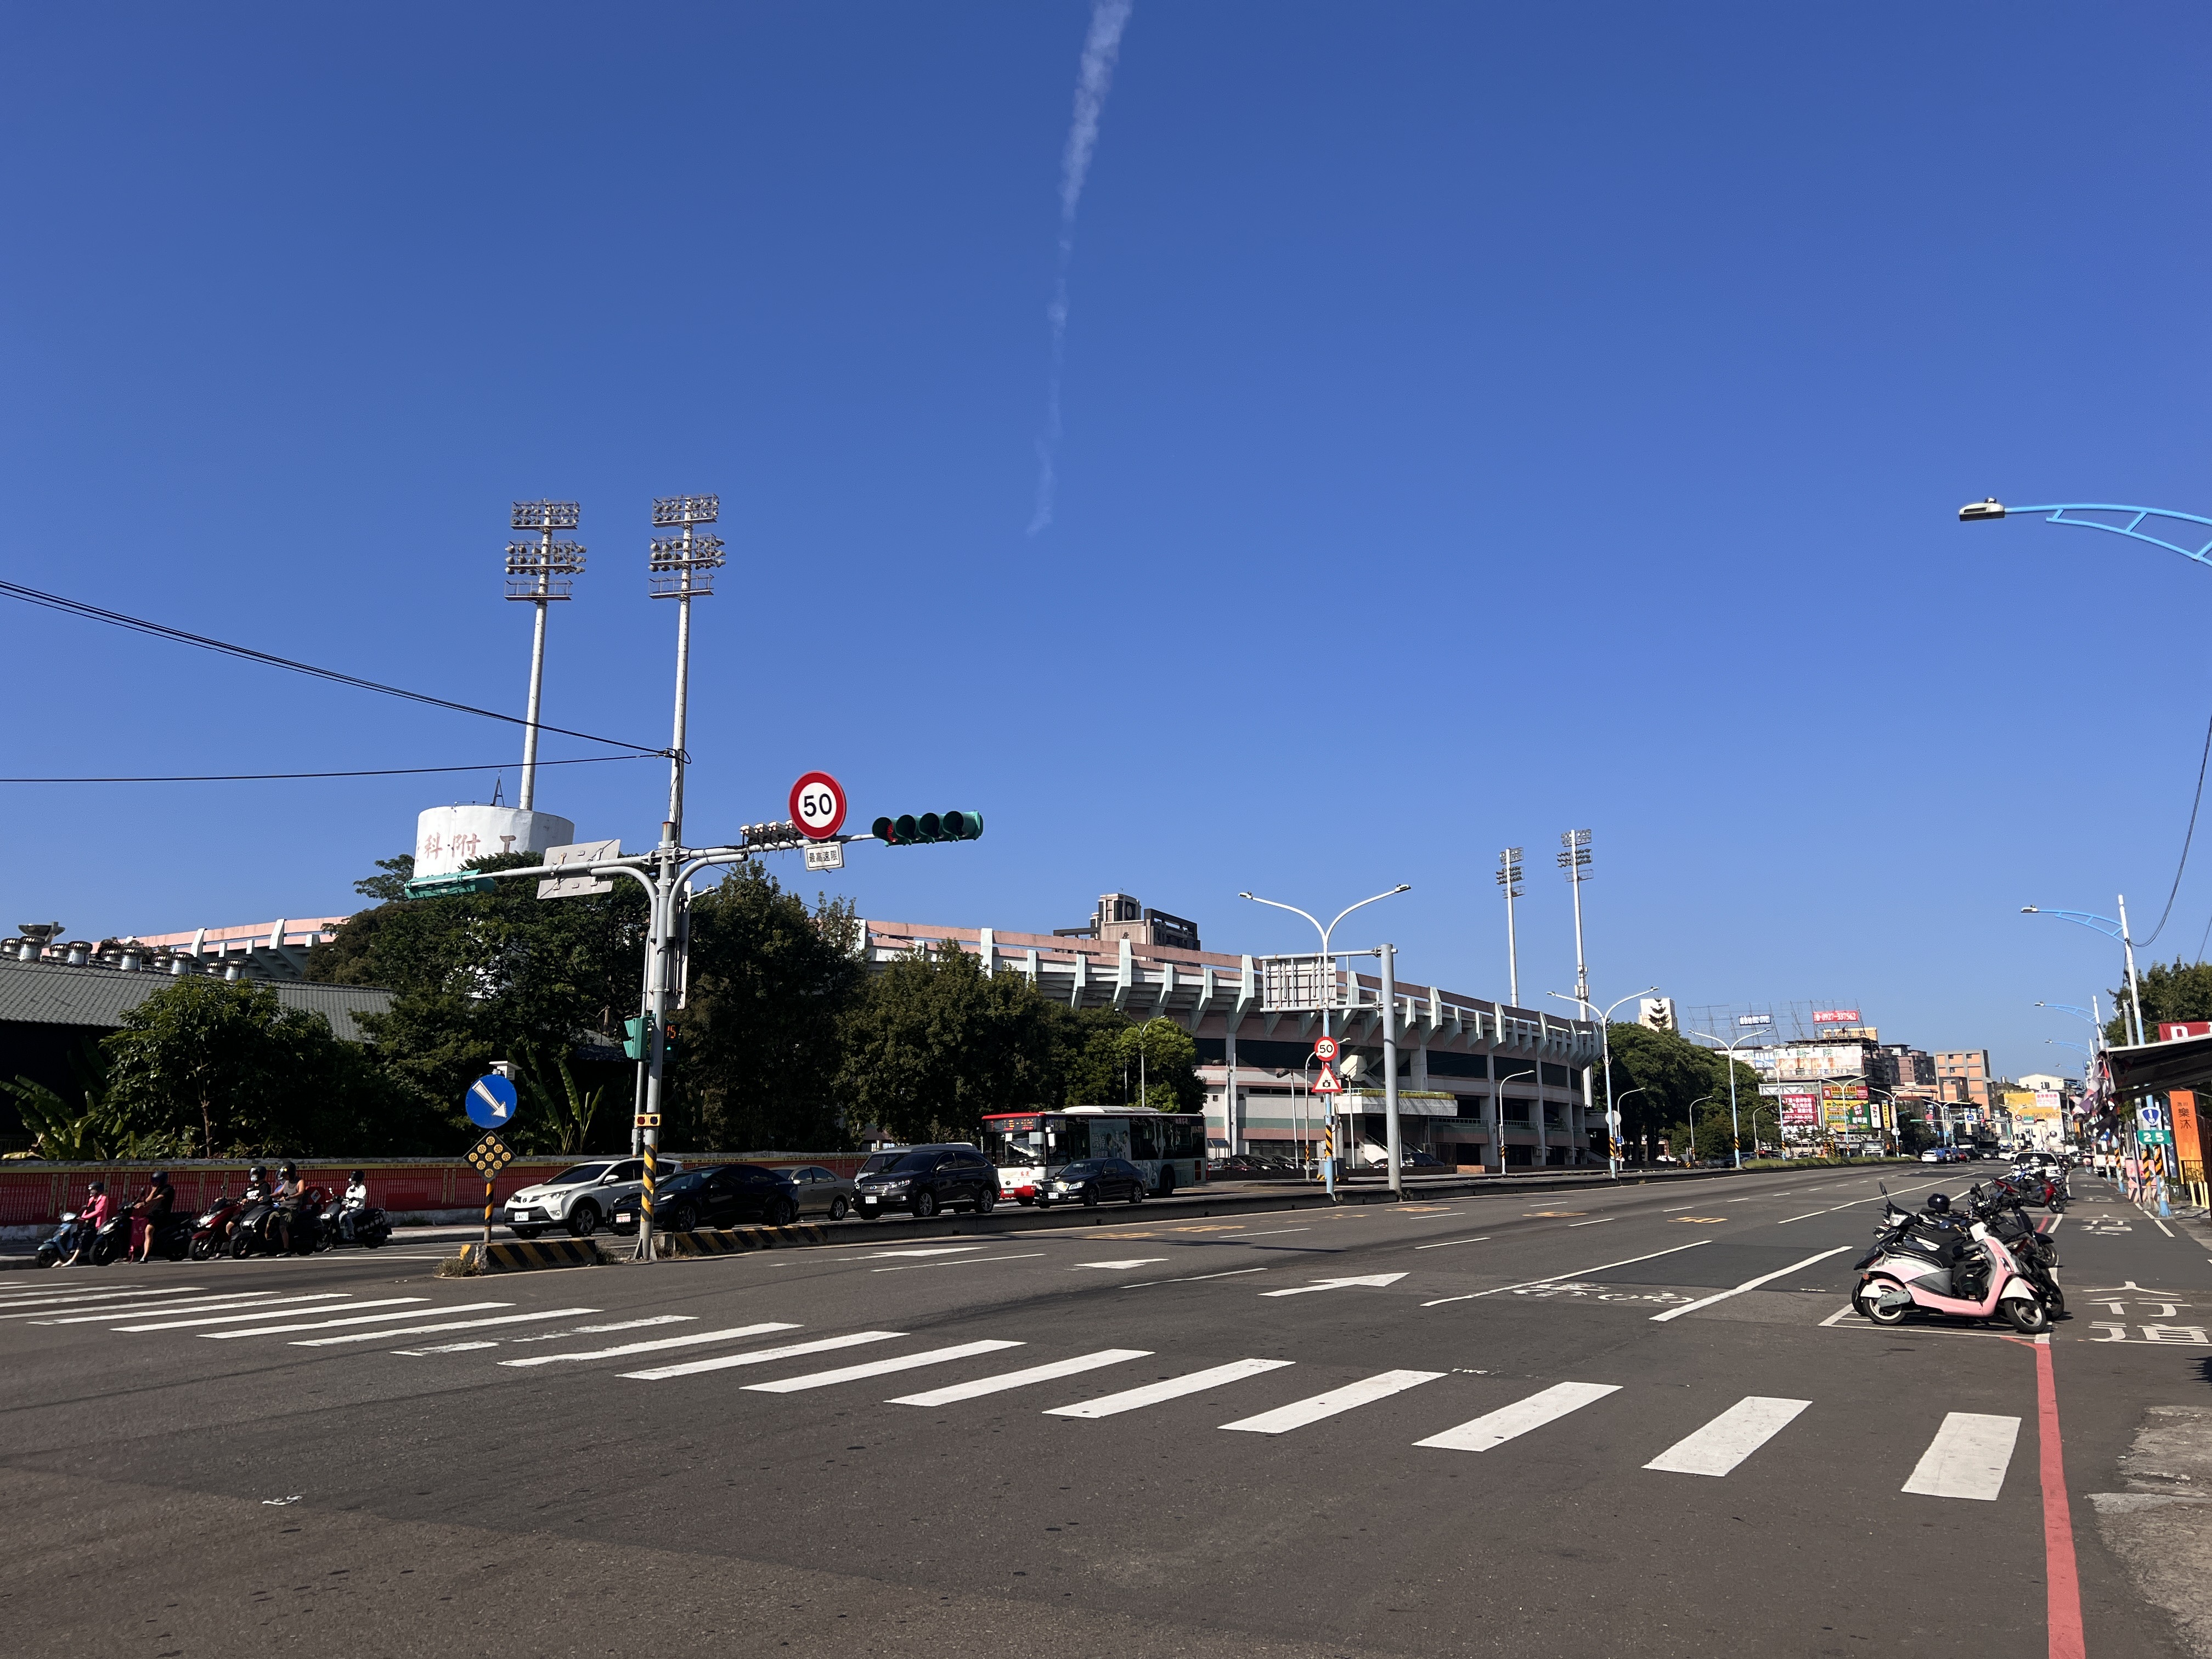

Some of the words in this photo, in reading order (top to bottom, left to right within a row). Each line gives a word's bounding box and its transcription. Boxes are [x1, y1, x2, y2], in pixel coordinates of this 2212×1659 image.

[803, 793, 832, 817] 50
[416, 832, 516, 863] 科附工
[809, 850, 838, 864] 最高速限
[1319, 1044, 1334, 1053] 50
[2147, 1109, 2153, 1118] 1
[2178, 1107, 2192, 1129] 樂沐
[2143, 1132, 2165, 1142] 25
